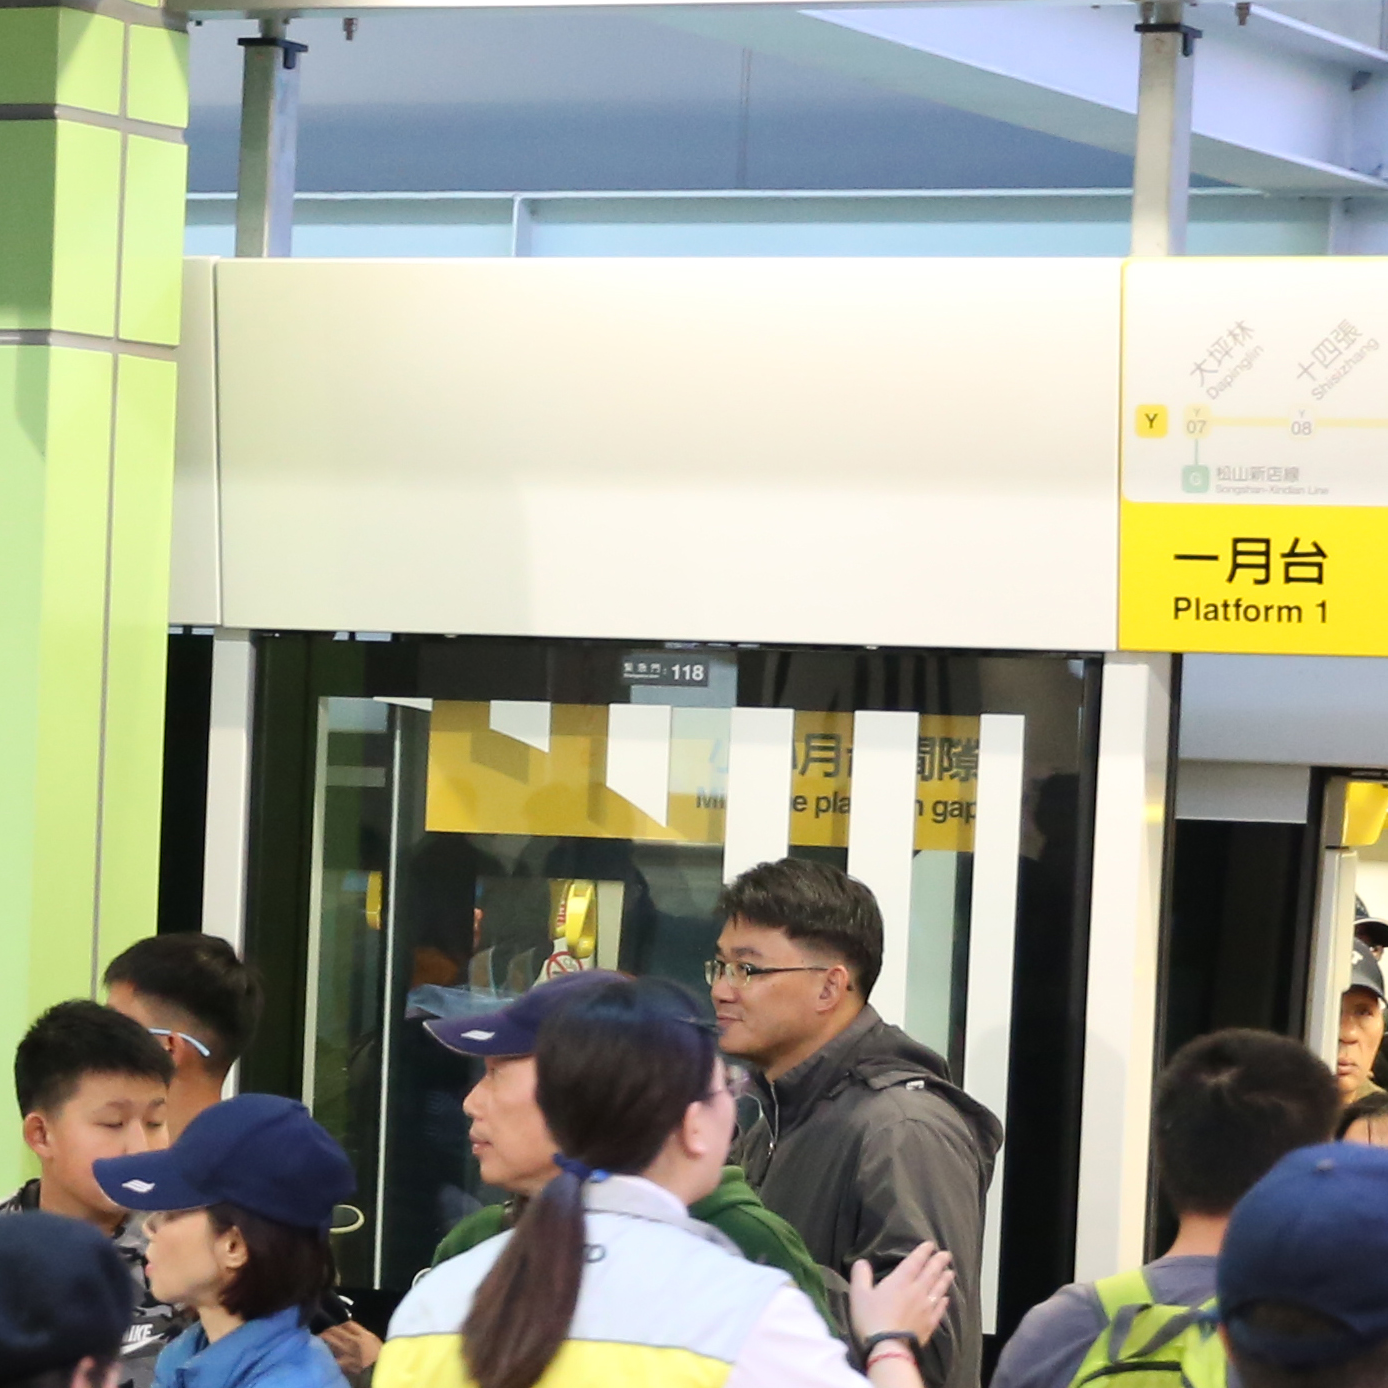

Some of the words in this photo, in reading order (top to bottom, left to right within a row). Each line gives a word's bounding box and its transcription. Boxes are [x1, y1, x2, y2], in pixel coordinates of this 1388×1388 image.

[1189, 319, 1255, 387] 大坪林
[1295, 318, 1363, 383] 十四張
[1205, 343, 1264, 401] Dapinglin
[1311, 337, 1380, 401] Shisizhang
[1145, 414, 1157, 429] Y
[1186, 419, 1207, 435] 07
[1291, 422, 1312, 436] 08
[1174, 537, 1328, 586] 一月台
[1173, 597, 1303, 623] Platform
[1317, 601, 1328, 623] 1
[671, 664, 704, 681] 118
[931, 799, 977, 823] gap
